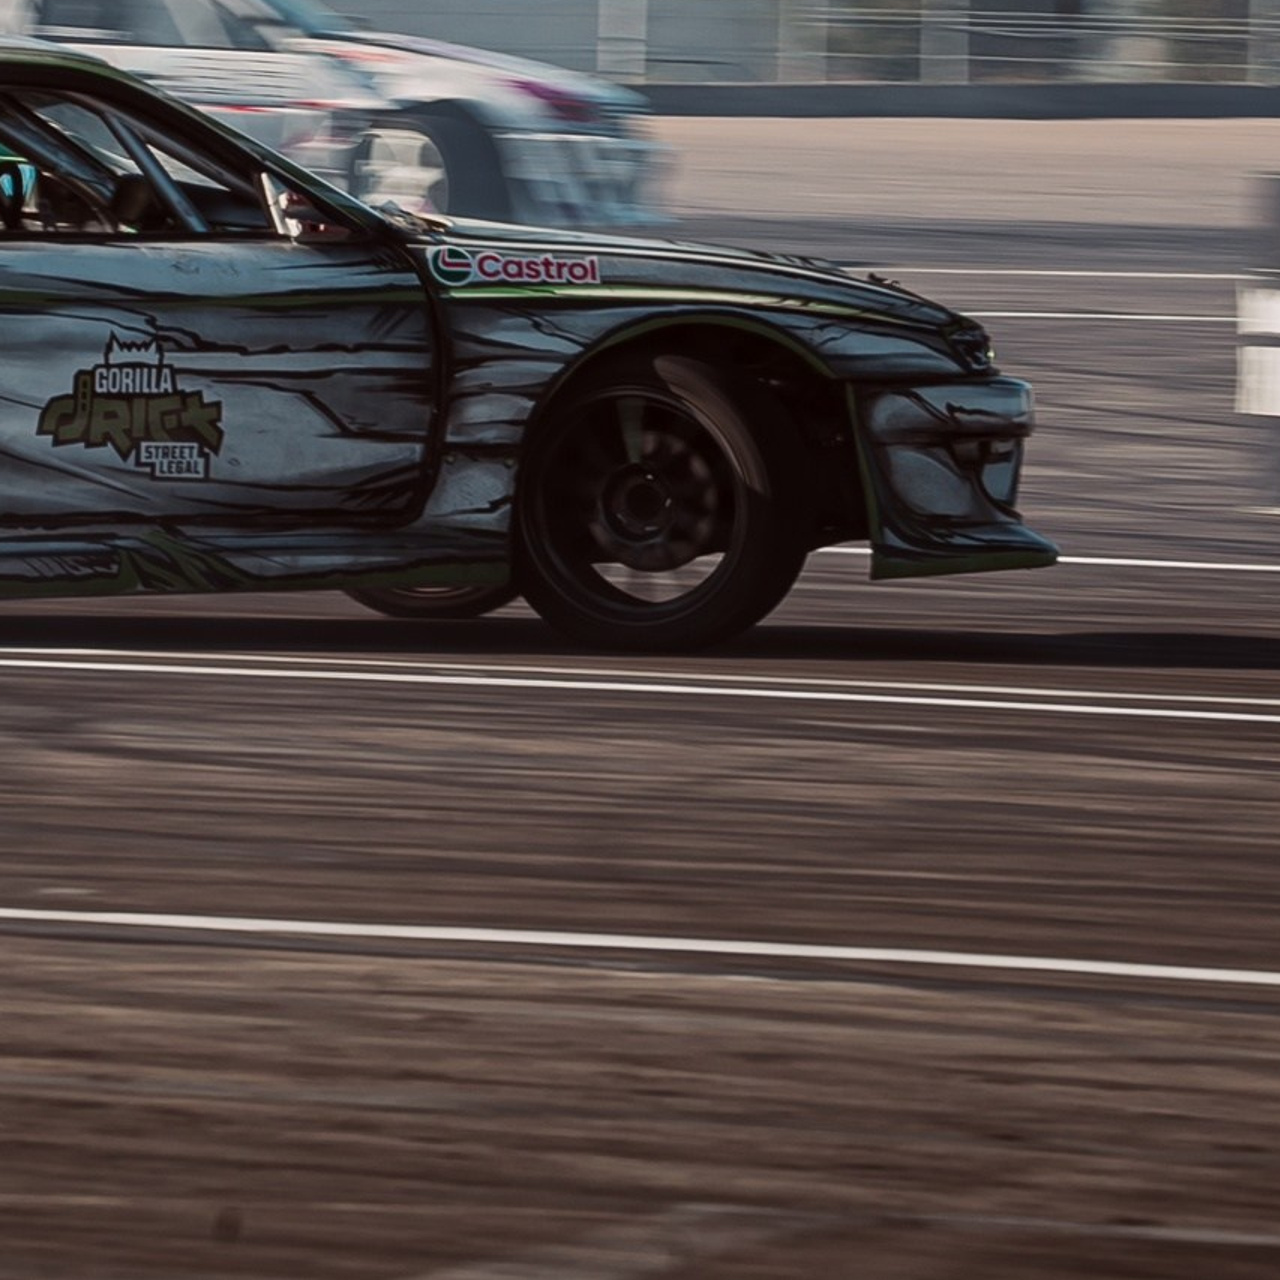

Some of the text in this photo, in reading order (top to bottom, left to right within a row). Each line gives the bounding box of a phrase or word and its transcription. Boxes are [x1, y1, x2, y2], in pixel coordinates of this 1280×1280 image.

[477, 254, 598, 282] Castrol
[94, 367, 173, 394] GORILLA
[144, 445, 196, 460] STREET
[159, 460, 201, 475] LEGAL
